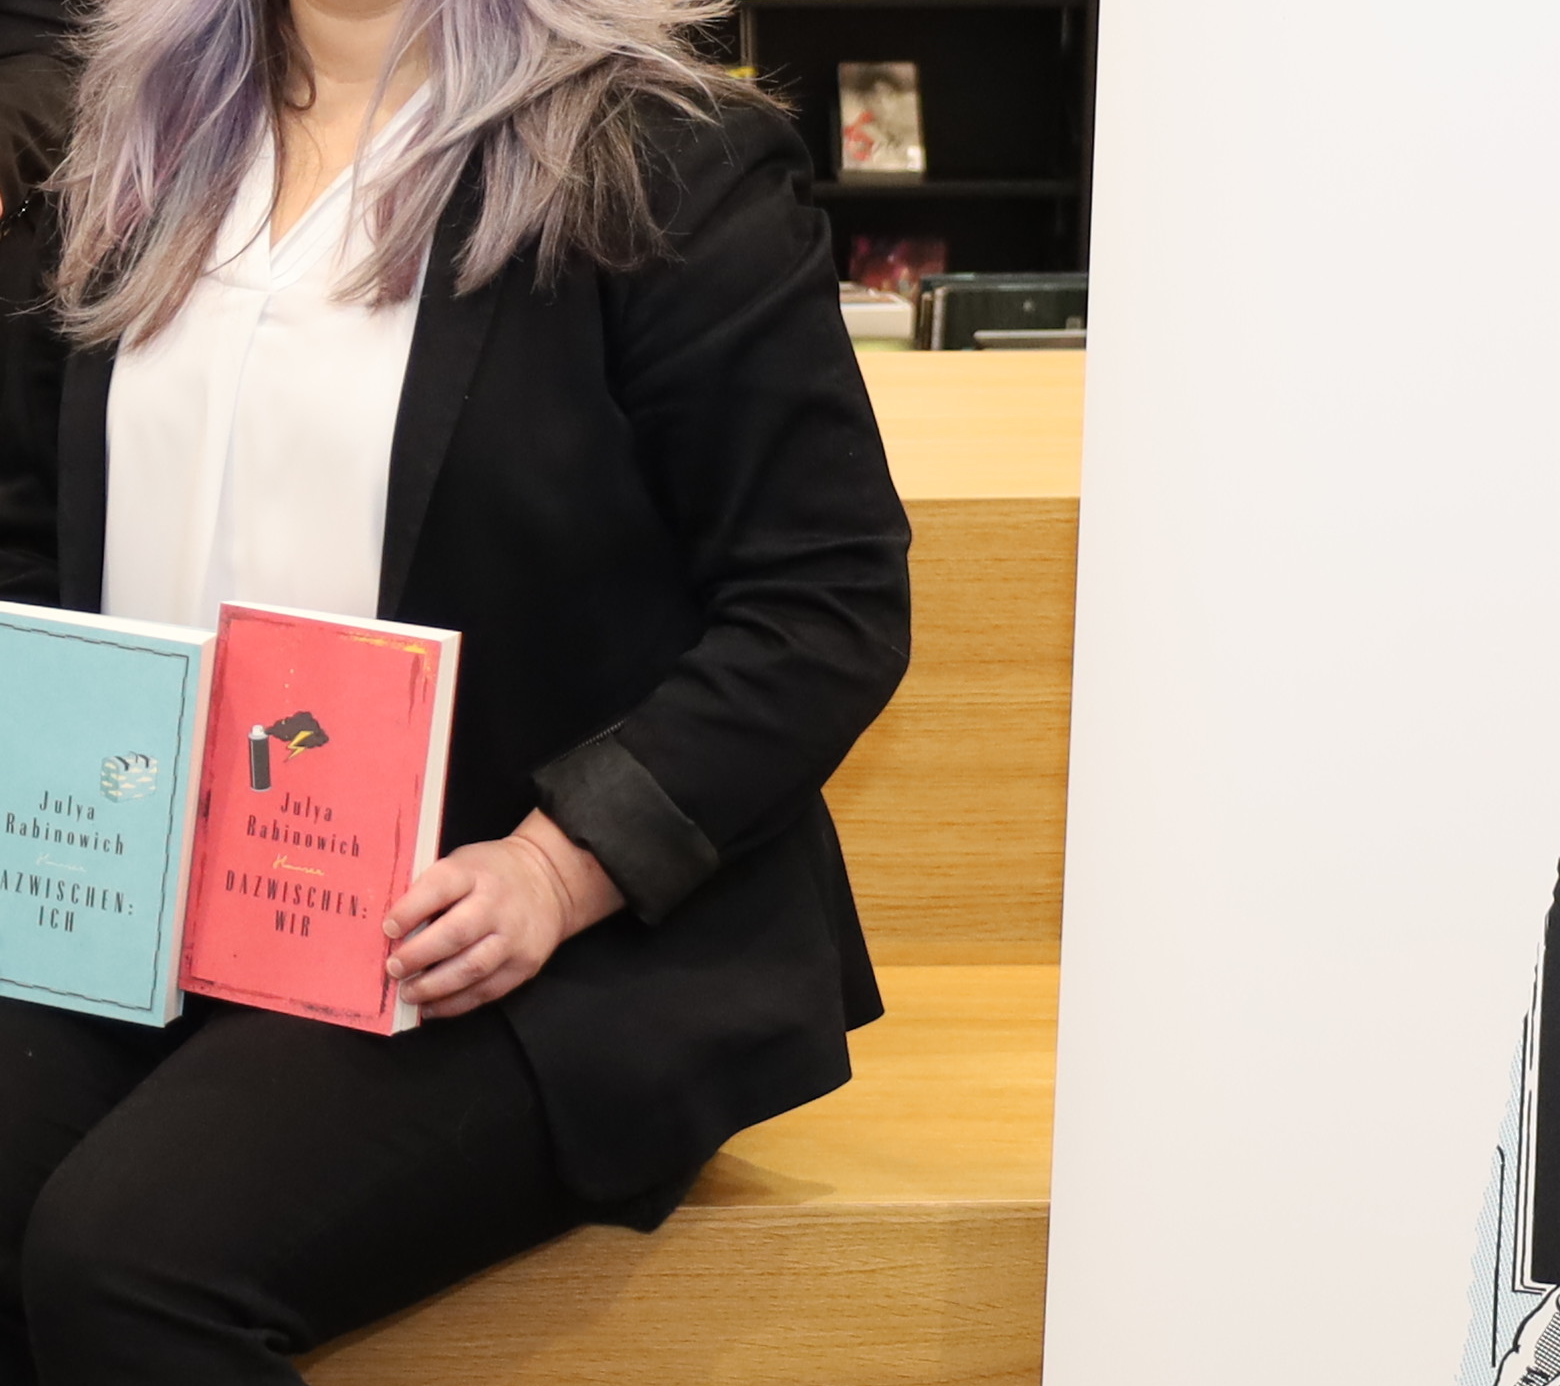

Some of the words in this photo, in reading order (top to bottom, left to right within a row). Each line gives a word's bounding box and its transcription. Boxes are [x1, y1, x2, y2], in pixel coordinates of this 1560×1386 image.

[38, 790, 96, 822] Julya
[280, 791, 334, 823] Julya
[5, 811, 126, 855] Rabinowich
[246, 814, 361, 858] Rabinowich
[224, 868, 368, 919] DAZWISCHEN:
[38, 906, 76, 934] ICH
[274, 912, 311, 937] WIR
